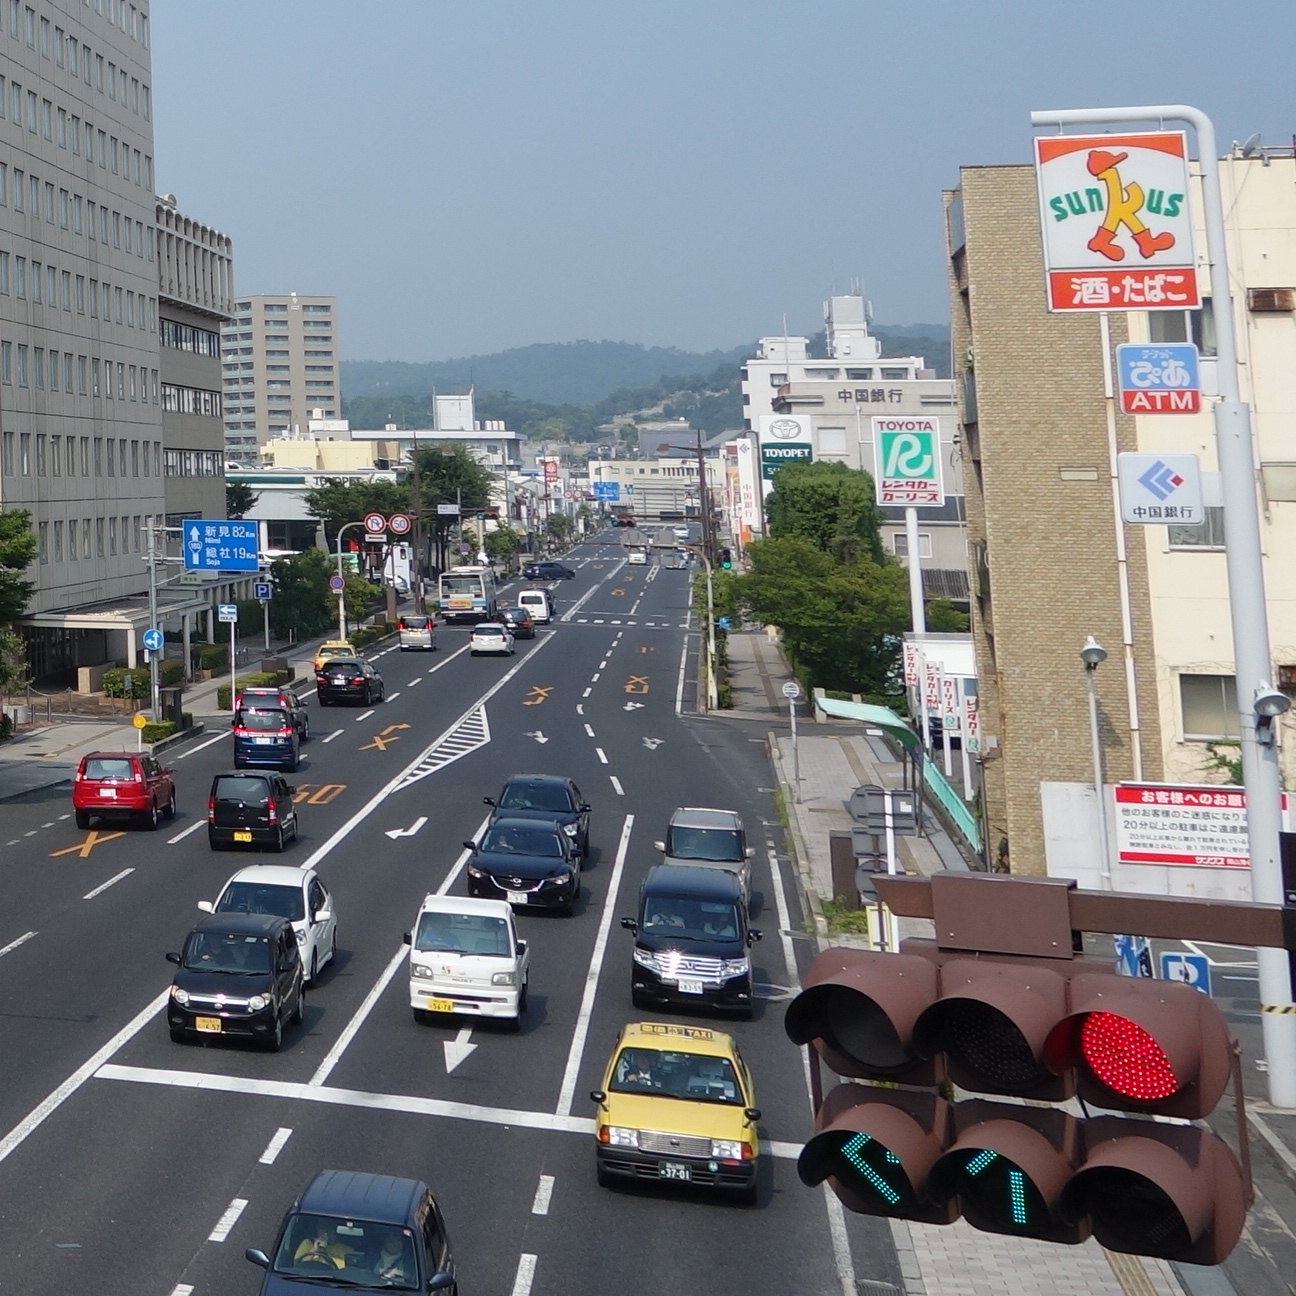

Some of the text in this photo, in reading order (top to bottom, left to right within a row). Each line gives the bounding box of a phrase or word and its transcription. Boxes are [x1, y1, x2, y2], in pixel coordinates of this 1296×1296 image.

[1129, 359, 1191, 388] ぴあ
[838, 388, 903, 404] 中国銀行
[1130, 391, 1193, 410] ATM
[877, 420, 934, 432] TOYOTA
[763, 448, 810, 458] TOYOPET
[881, 481, 938, 490] レンタカー
[882, 492, 939, 502] カーリース
[1133, 505, 1193, 519] 中国銀行
[394, 519, 406, 529] 50
[204, 525, 231, 538] 新見
[205, 546, 232, 559] 総社
[257, 585, 268, 597] P
[926, 663, 936, 695] レンタカー
[943, 680, 954, 714] カーリース
[966, 699, 978, 736] レンタカー
[686, 1029, 712, 1040] TAXI
